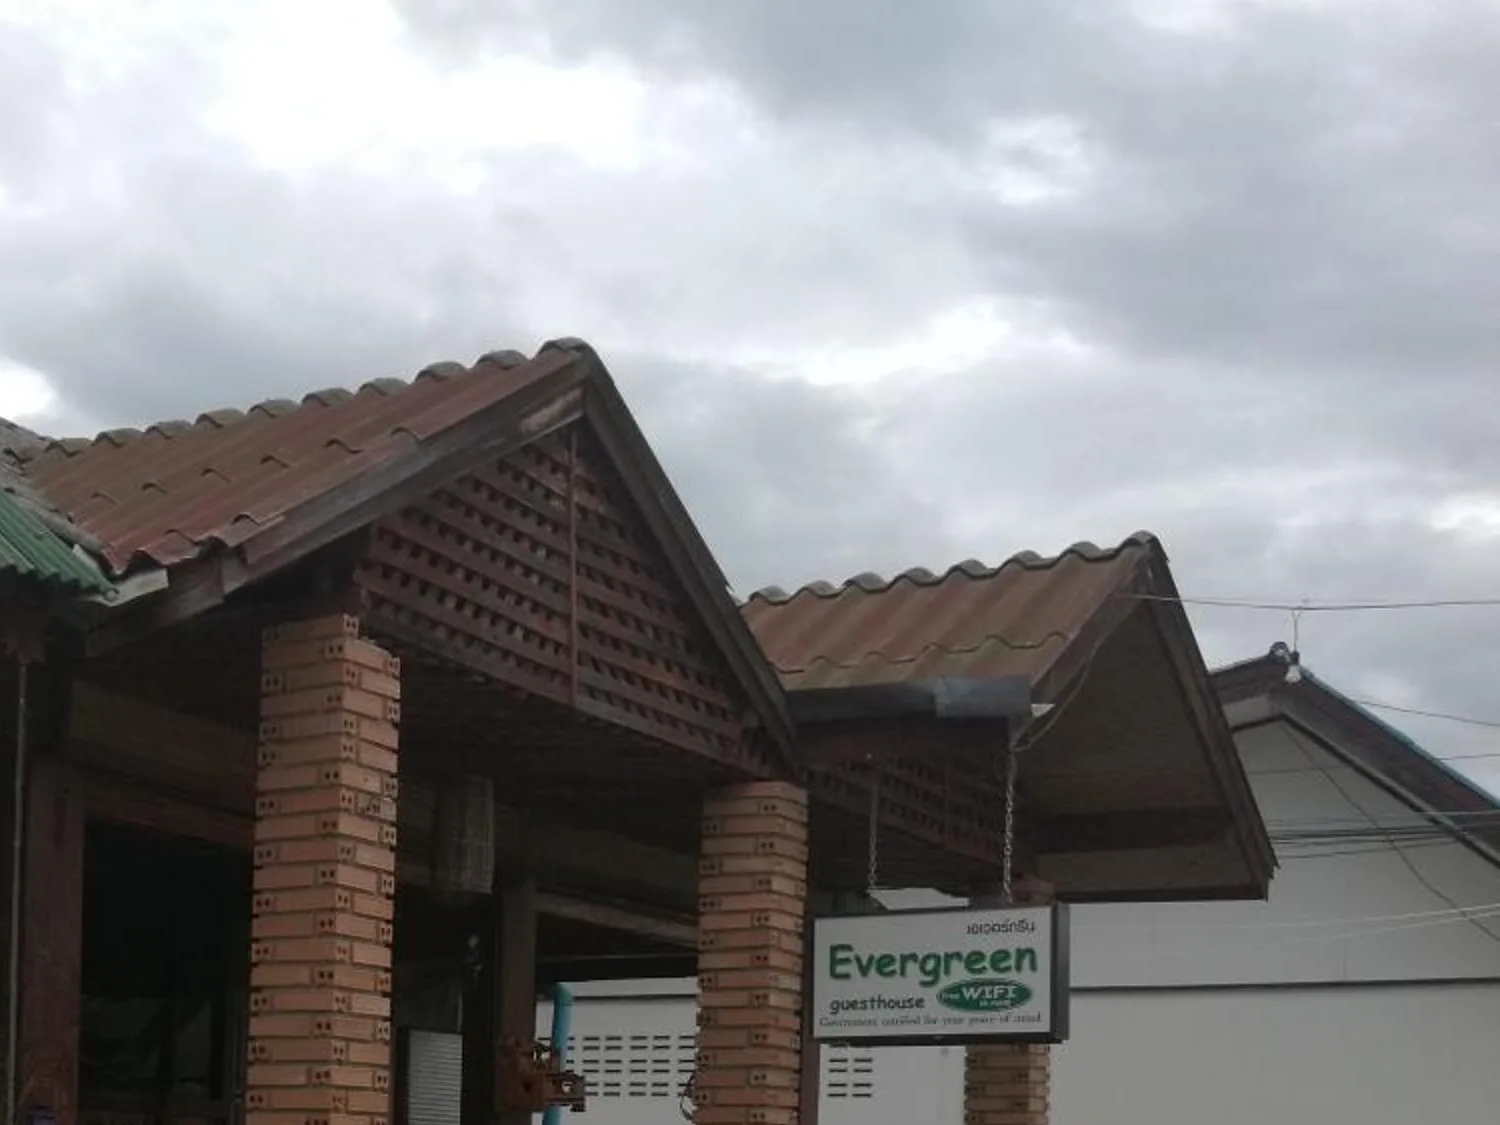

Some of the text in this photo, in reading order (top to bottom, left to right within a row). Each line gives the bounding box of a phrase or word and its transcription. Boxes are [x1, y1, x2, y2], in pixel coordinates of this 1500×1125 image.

[828, 943, 1038, 987] Evergreen
[961, 985, 1018, 1000] WIFI
[829, 994, 925, 1015] guesthouse
